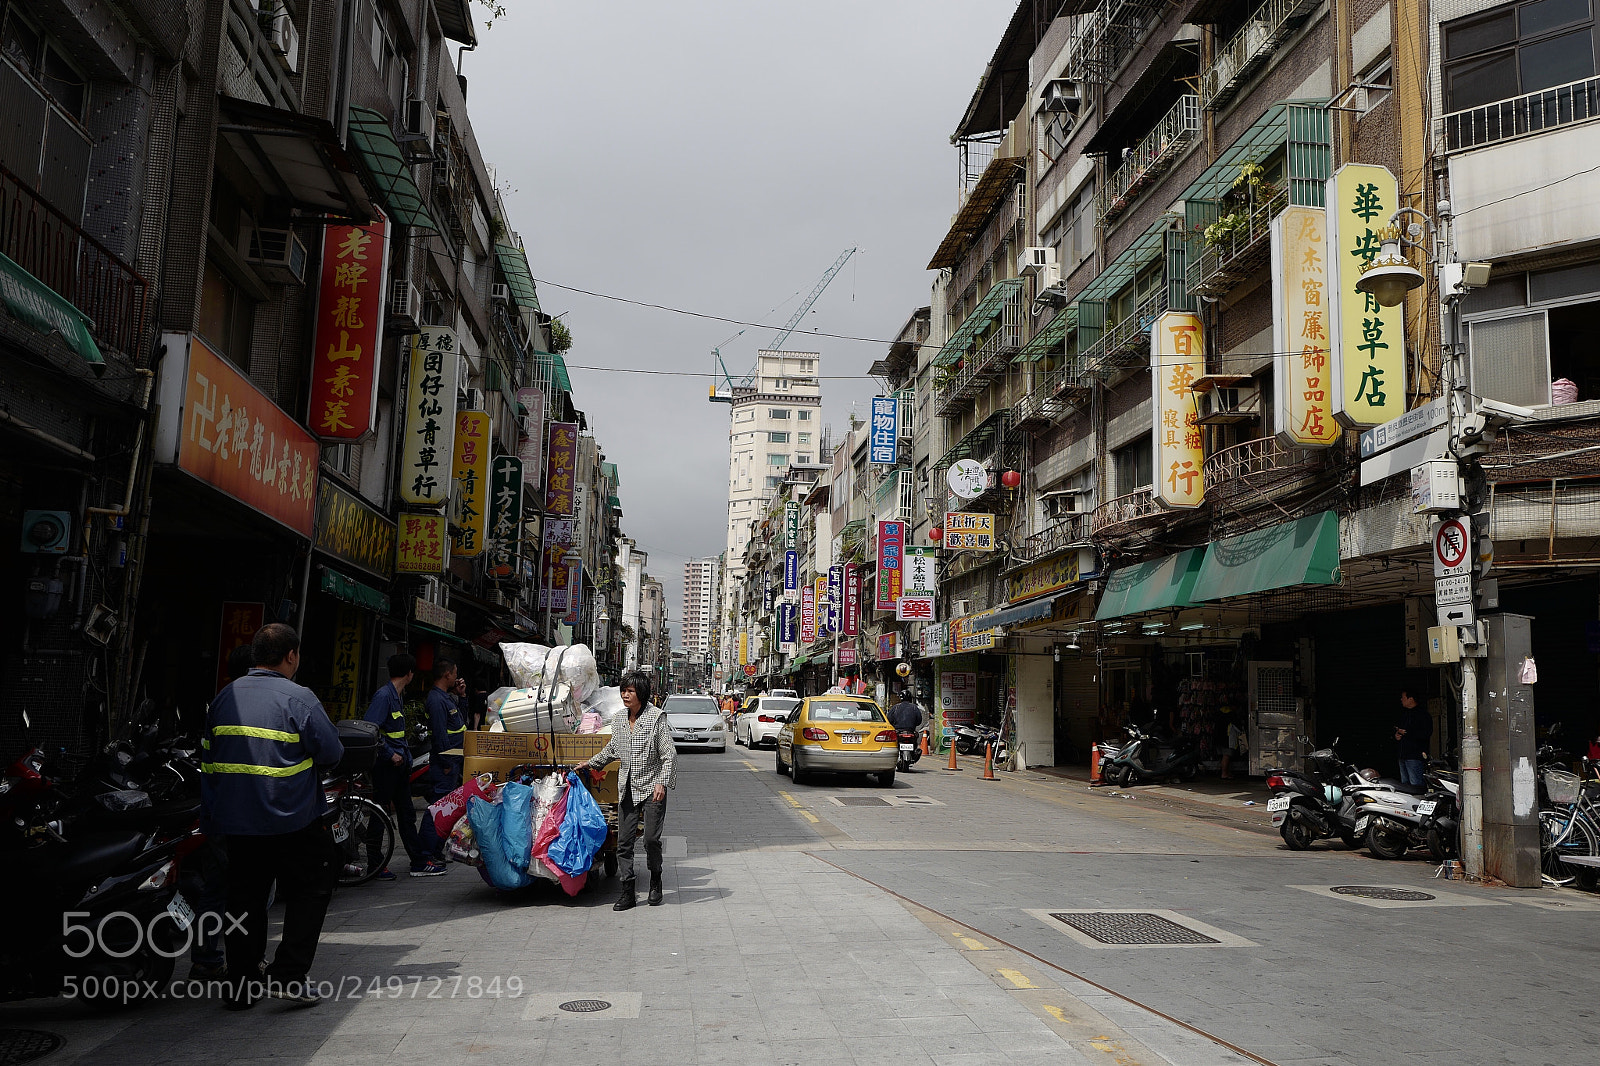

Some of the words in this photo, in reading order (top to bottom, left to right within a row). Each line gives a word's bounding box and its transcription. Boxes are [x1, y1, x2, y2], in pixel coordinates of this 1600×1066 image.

[320, 229, 373, 433] 老牌龍山素菜
[1427, 406, 1446, 420] 100m
[872, 400, 895, 461] 寵物住宿
[950, 515, 990, 529] 五折天
[883, 523, 899, 569] 第一寵物
[949, 533, 991, 548] 歡喜購
[1443, 531, 1460, 557] 停
[787, 554, 795, 588] Panasonic
